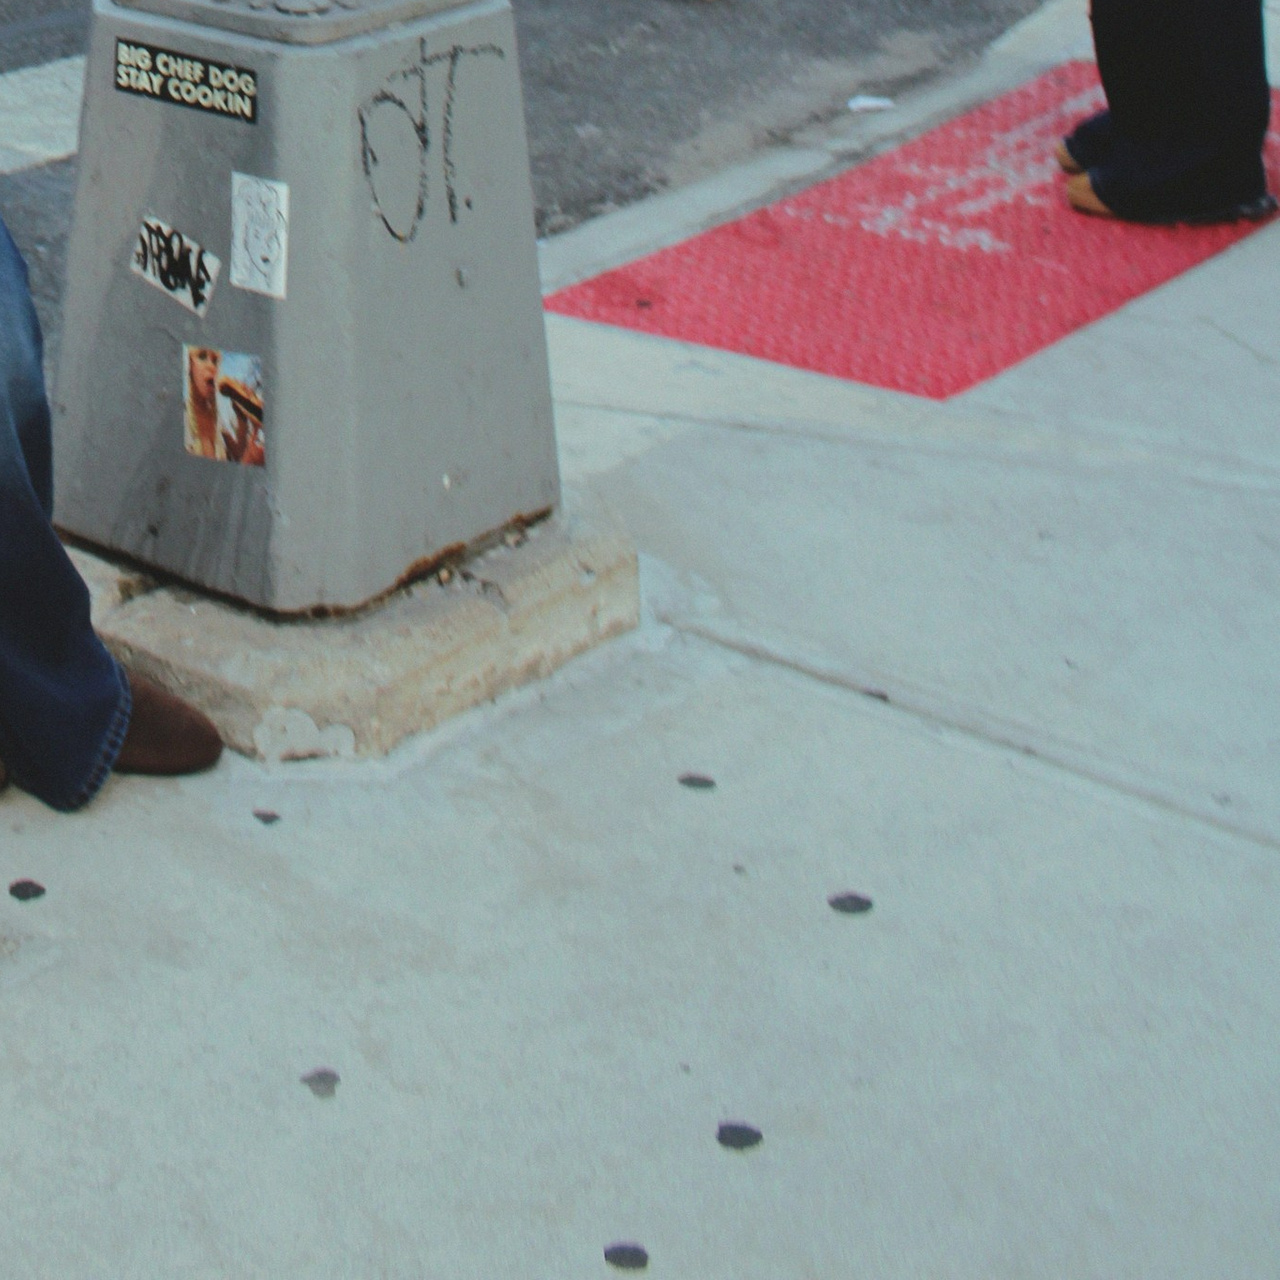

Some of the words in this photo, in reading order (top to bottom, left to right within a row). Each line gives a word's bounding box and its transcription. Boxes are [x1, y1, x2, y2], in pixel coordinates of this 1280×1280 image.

[116, 64, 164, 96] STAY
[167, 77, 253, 119] COOKIN
[117, 41, 153, 72] BIG
[155, 52, 205, 84] CHEF
[208, 64, 257, 97] DOG
